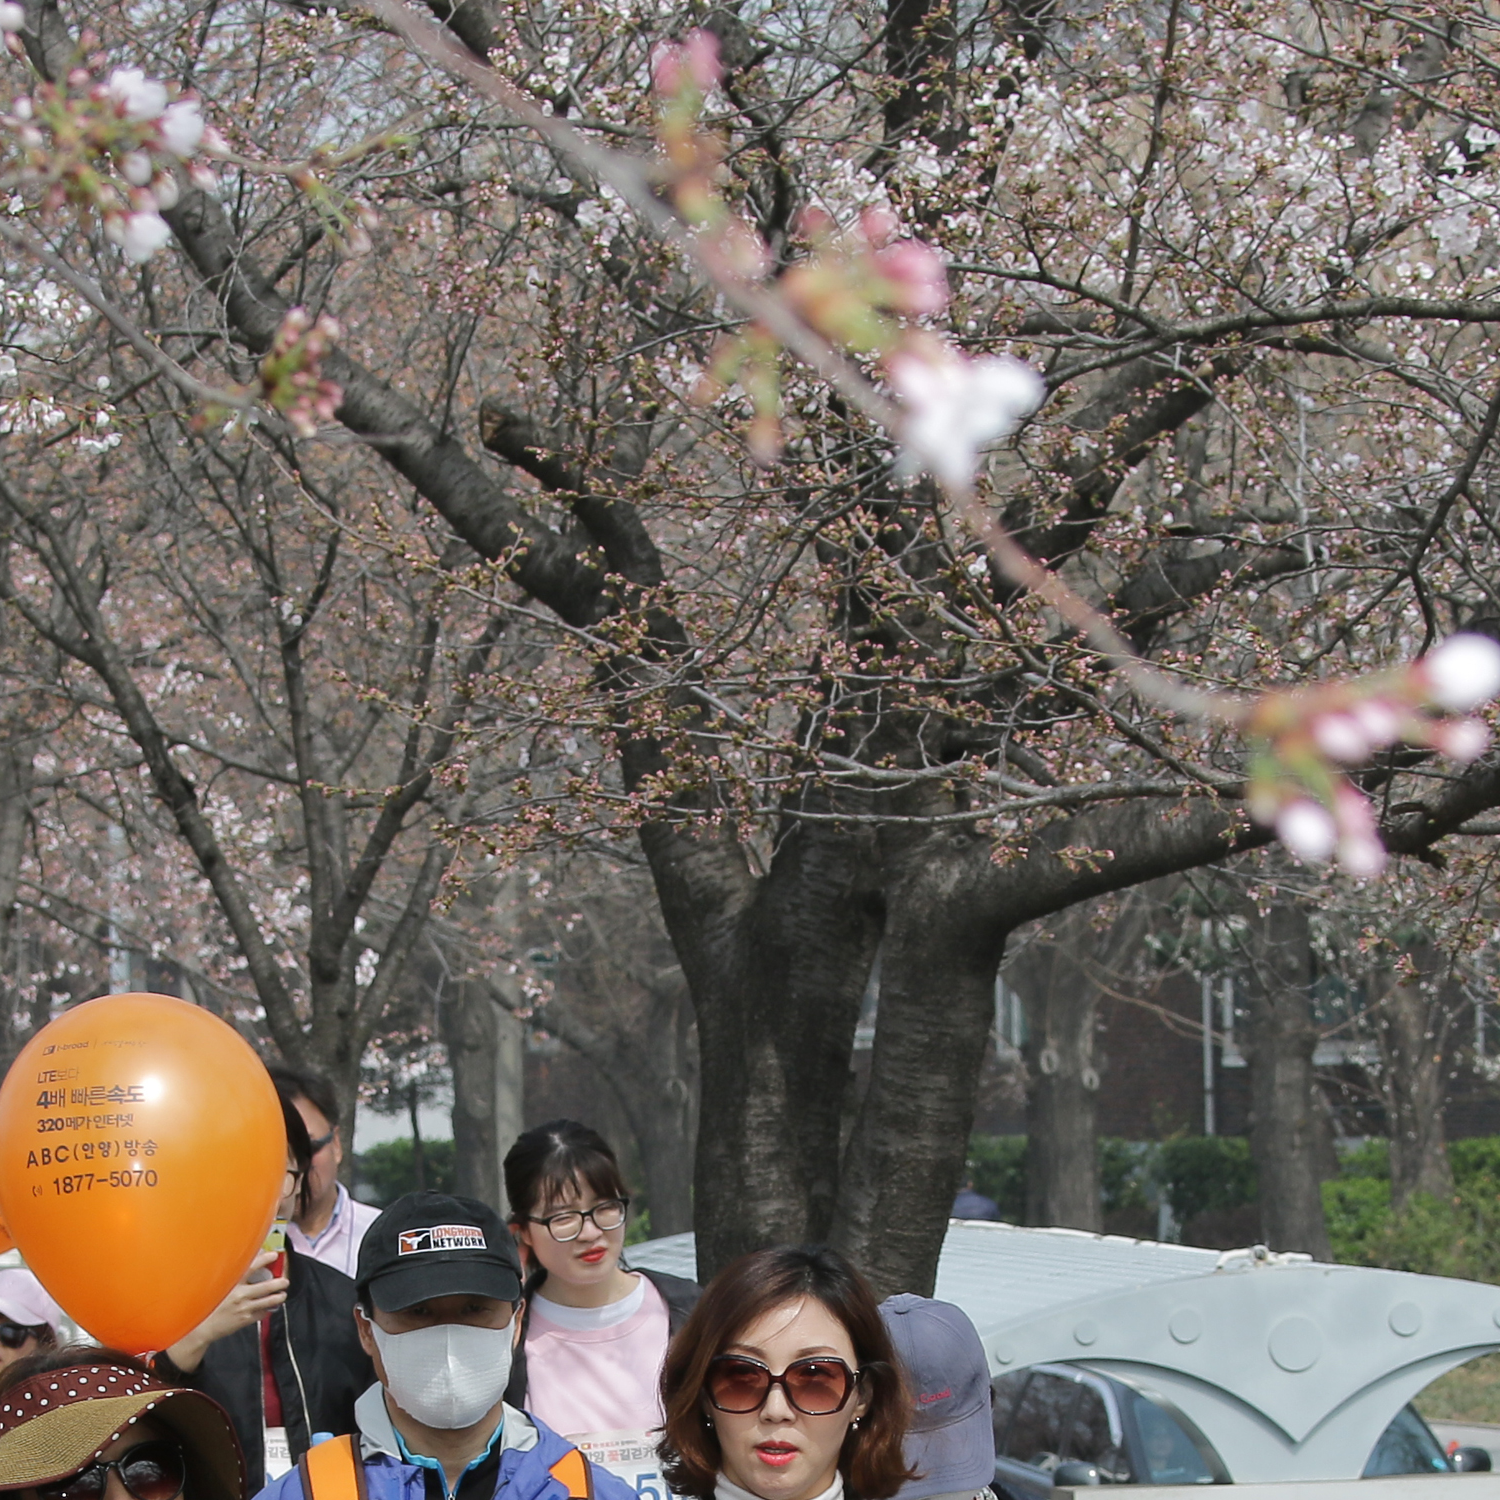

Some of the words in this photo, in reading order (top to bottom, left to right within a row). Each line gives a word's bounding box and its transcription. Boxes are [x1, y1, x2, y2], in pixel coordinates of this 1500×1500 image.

[36, 1088, 66, 1109] 4배
[53, 1170, 158, 1195] 1877-5070
[433, 1237, 485, 1248] NETWORK
